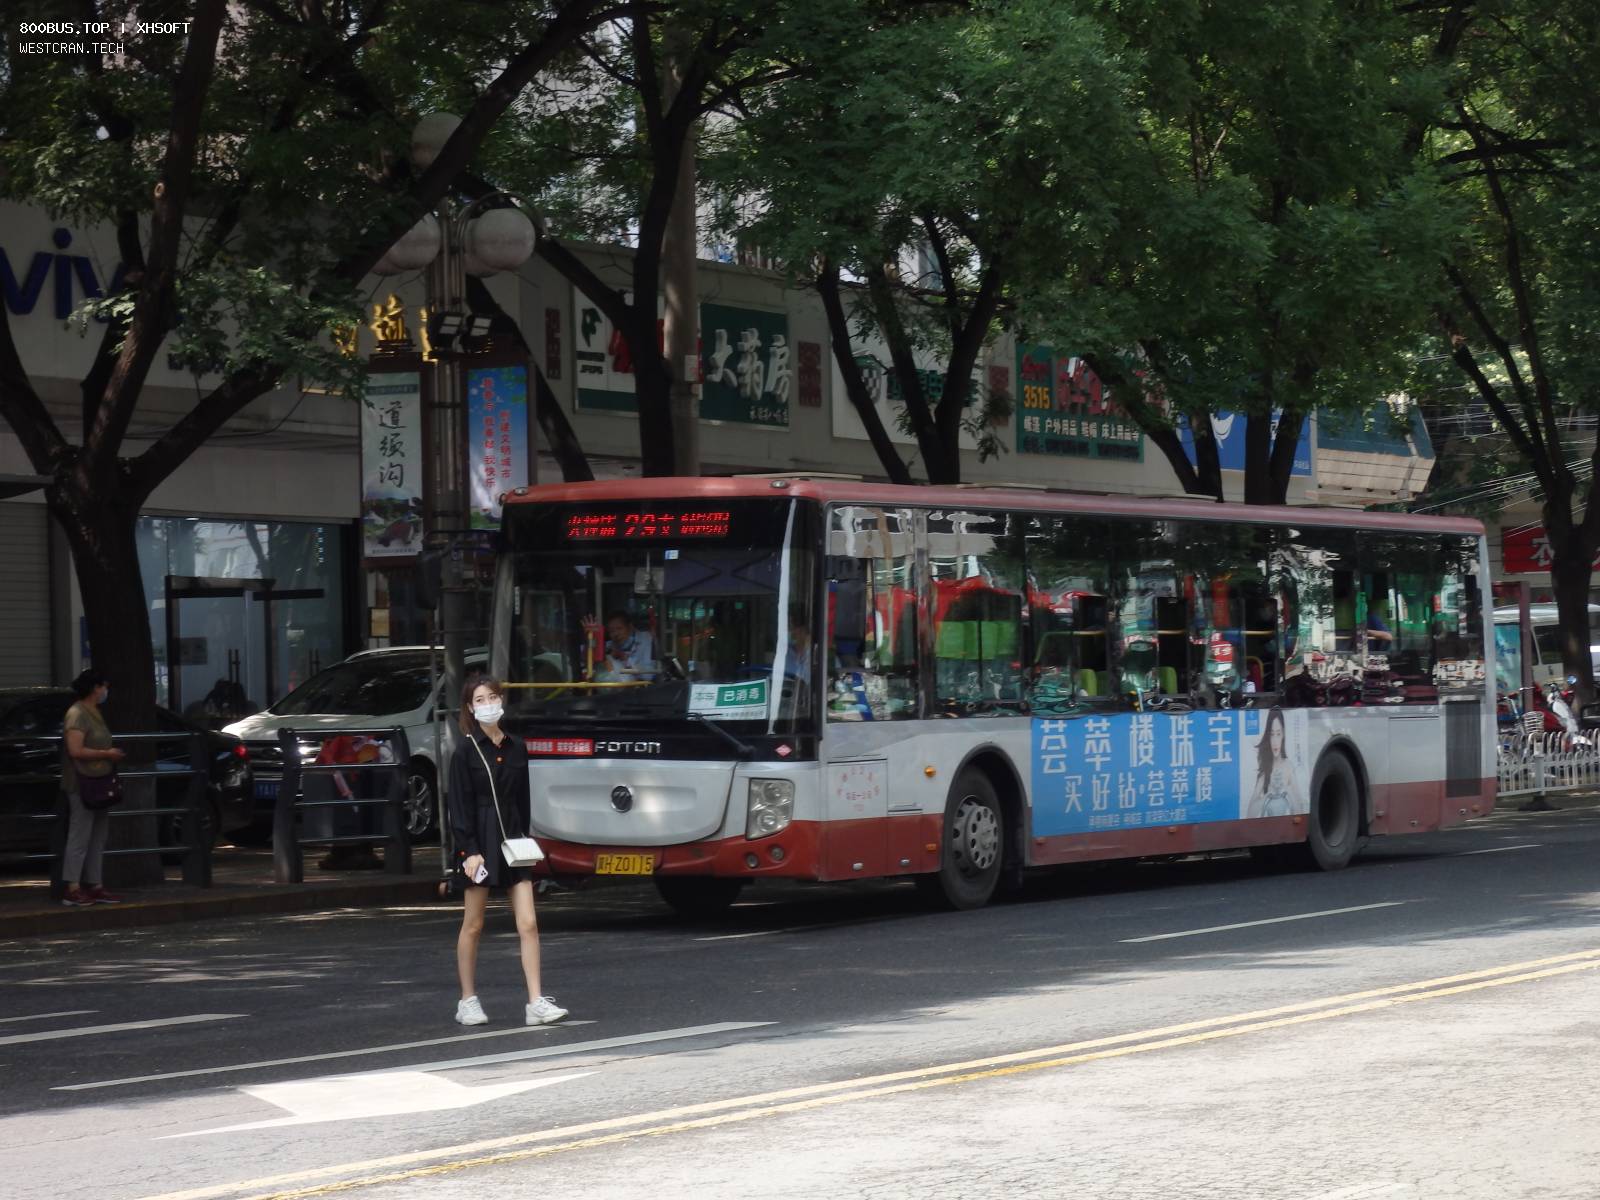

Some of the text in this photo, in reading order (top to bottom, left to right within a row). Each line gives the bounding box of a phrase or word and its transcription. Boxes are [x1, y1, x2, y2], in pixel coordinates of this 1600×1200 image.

[0, 228, 184, 324] viv
[1023, 384, 1051, 409] 3515
[594, 741, 662, 754] FOTON
[1040, 713, 1232, 774] 荟萃楼珠宝
